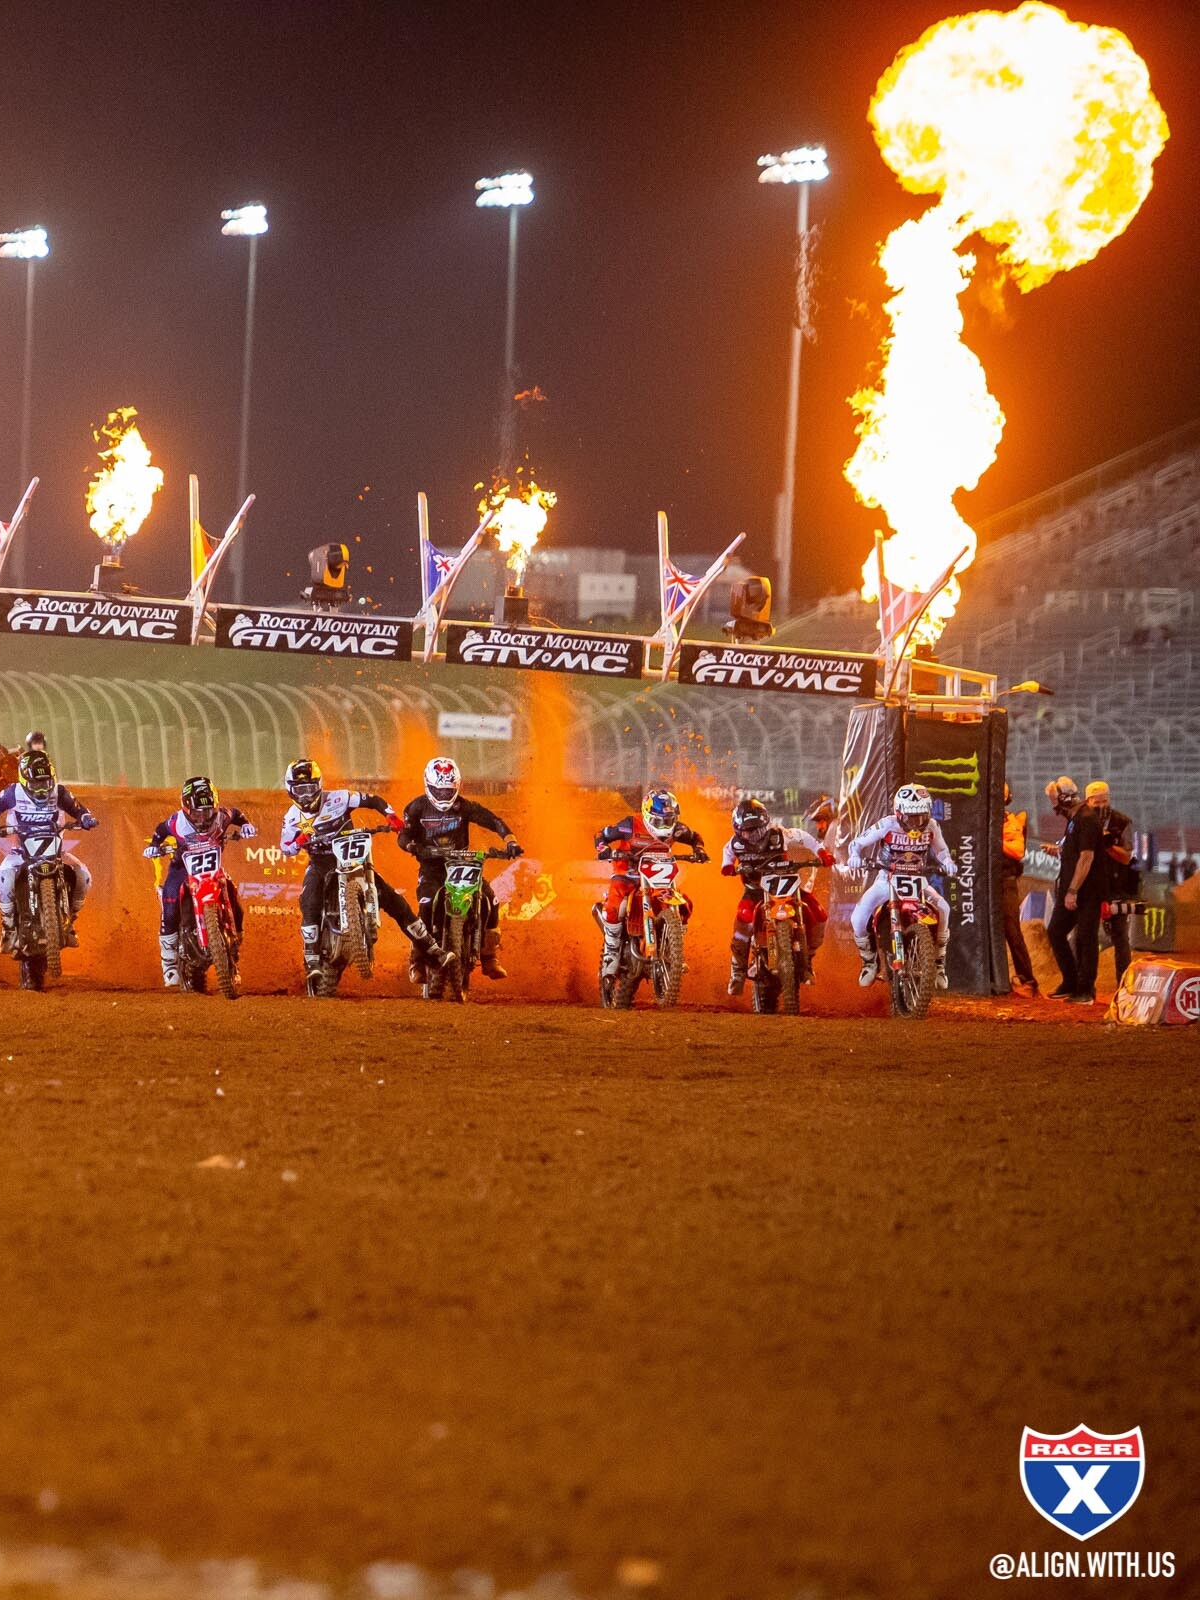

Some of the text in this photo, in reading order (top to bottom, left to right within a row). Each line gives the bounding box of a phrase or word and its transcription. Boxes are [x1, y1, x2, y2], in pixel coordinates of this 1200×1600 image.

[35, 597, 180, 621] ROCKY MOUNTAIN
[255, 613, 400, 637] ROCKY MOUNTAIN
[485, 629, 631, 654] ROCKY MOUNTAIN
[719, 648, 864, 675] ROCKY MOUNTAIN
[34, 837, 54, 857] 7
[340, 840, 366, 860] 15
[191, 852, 217, 876] 23
[649, 863, 673, 884] 2
[448, 867, 481, 884] 44
[767, 876, 798, 896] 17
[896, 876, 921, 897] 51
[959, 836, 975, 925] MONSTER
